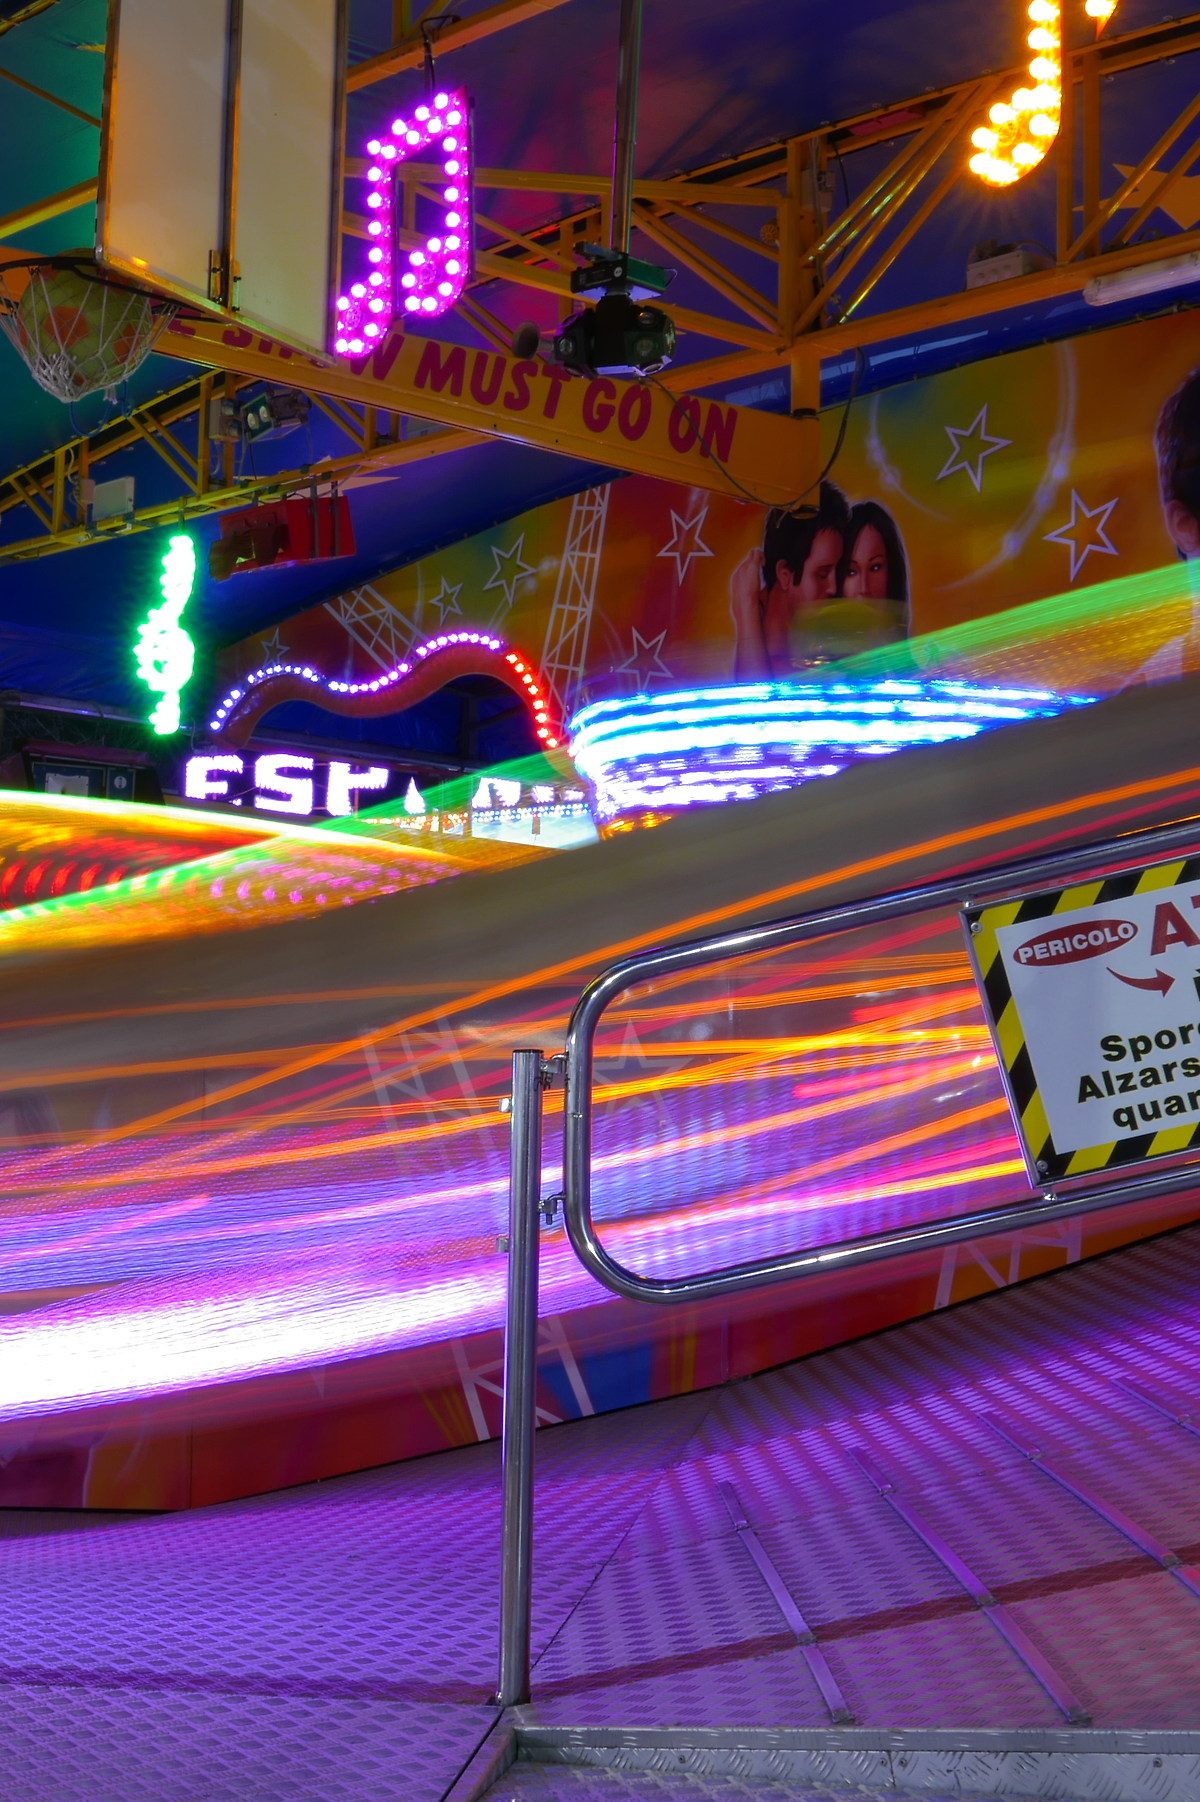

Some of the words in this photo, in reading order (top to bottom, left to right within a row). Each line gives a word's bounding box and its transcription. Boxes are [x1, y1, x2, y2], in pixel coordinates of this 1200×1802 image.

[413, 341, 571, 420] MUST
[582, 379, 652, 441] GO
[667, 395, 738, 464] ON
[1018, 922, 1135, 963] PERICOLO
[1100, 1022, 1200, 1063] Spor
